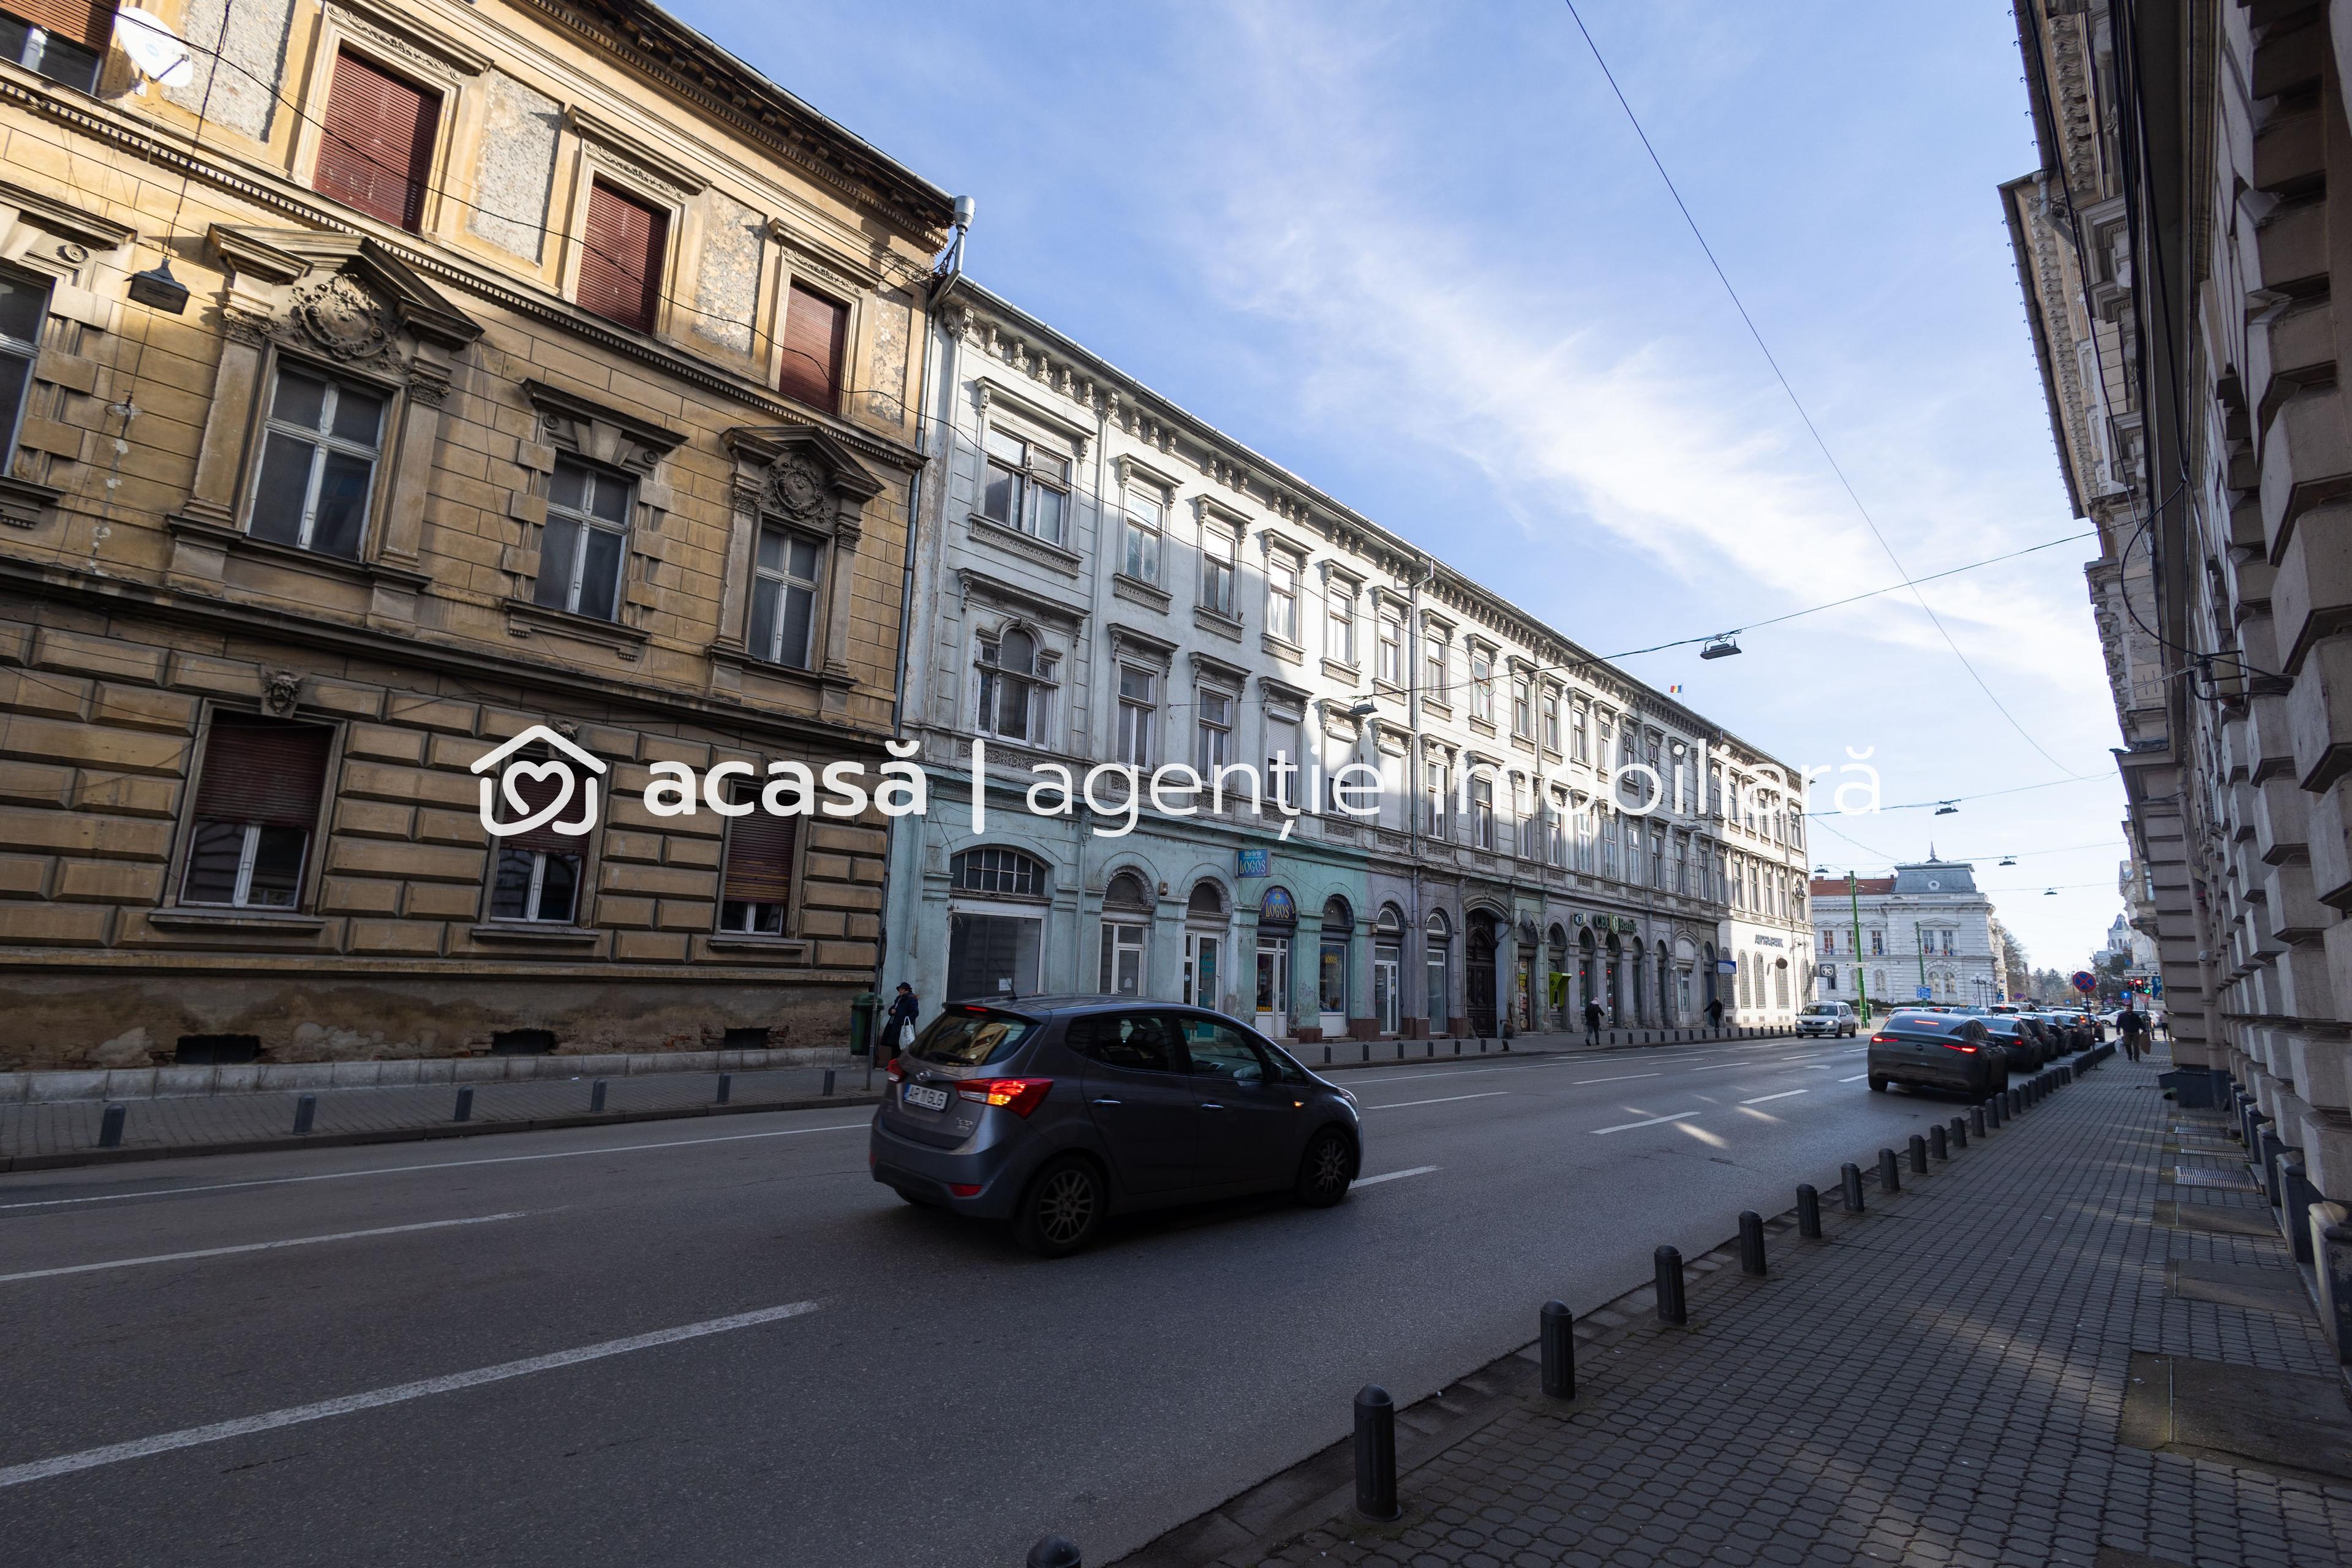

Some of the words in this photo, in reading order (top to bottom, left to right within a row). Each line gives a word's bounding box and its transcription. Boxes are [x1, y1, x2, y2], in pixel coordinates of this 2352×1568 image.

[1240, 859, 1266, 873] LOGOS
[1266, 902, 1289, 919] LOGOS
[1325, 955, 1338, 964] LOGOS
